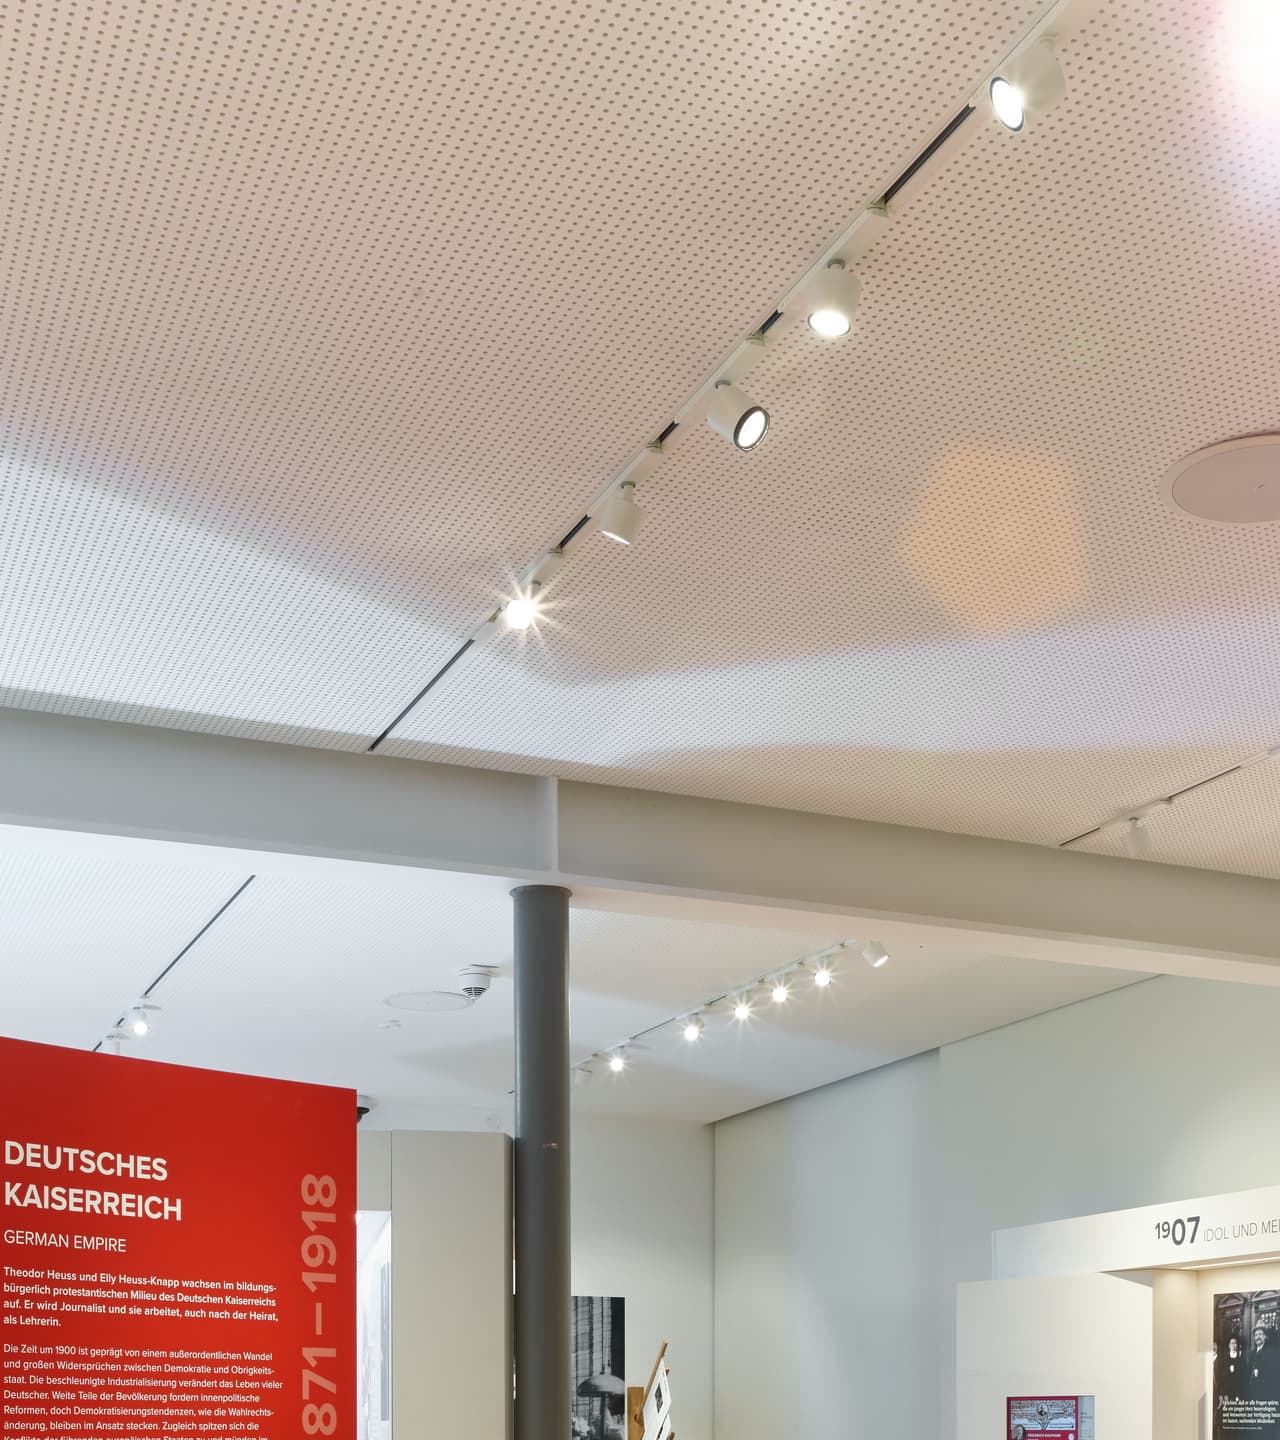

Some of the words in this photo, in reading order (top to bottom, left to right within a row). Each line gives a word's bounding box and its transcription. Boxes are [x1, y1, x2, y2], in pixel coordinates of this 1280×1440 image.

[4, 1140, 168, 1182] DEUTSCHES
[4, 1182, 183, 1221] KAISERREICH
[3, 1229, 70, 1248] GERMAN
[73, 1234, 127, 1253] EMPIRE
[1155, 1215, 1201, 1246] 1907
[1203, 1227, 1229, 1242] IDOL
[1232, 1222, 1258, 1239] UND
[3, 1268, 45, 1278] Theodor
[47, 1270, 77, 1280] Heuss
[79, 1272, 98, 1281] und
[99, 1273, 116, 1285] Elly
[118, 1274, 180, 1288] Heuss-Knapp
[181, 1278, 221, 1288] wachsen
[223, 1280, 234, 1289] im
[3, 1284, 51, 1297] bürgerlich
[52, 1286, 128, 1301] protestantischen
[130, 1290, 157, 1300] Milieu
[158, 1292, 175, 1301] des
[176, 1293, 224, 1304] Deutschen
[224, 1295, 276, 1306] Kaiserreichs
[3, 1316, 18, 1325] als
[23, 1300, 34, 1309] Er
[36, 1301, 58, 1310] wird
[59, 1302, 106, 1313] Journalist
[108, 1304, 126, 1314] und
[128, 1305, 142, 1314] sie
[184, 1308, 206, 1318] auch
[208, 1309, 230, 1319] nach
[232, 1310, 247, 1320] der
[3, 1344, 19, 1352] Die
[20, 1344, 38, 1353] Zeit
[54, 1345, 76, 1354] 1900
[78, 1346, 88, 1354] ist
[89, 1346, 123, 1358] geprägt
[141, 1348, 168, 1357] einem
[168, 1348, 242, 1359] außerordentlichen
[242, 1351, 272, 1360] Wandel
[3, 1359, 21, 1368] und
[22, 1360, 55, 1371] großen
[56, 1360, 122, 1373] Widersprüchen
[123, 1362, 162, 1371] zwischen
[163, 1363, 212, 1373] Demokratie
[213, 1364, 229, 1373] und
[28, 1375, 44, 1384] Die
[46, 1376, 106, 1387] beschleunigte
[107, 1377, 177, 1388] Industrialisierung
[178, 1378, 218, 1387] verändert
[218, 1379, 234, 1387] das
[235, 1379, 260, 1388] Leben
[260, 1379, 283, 1388] vieler
